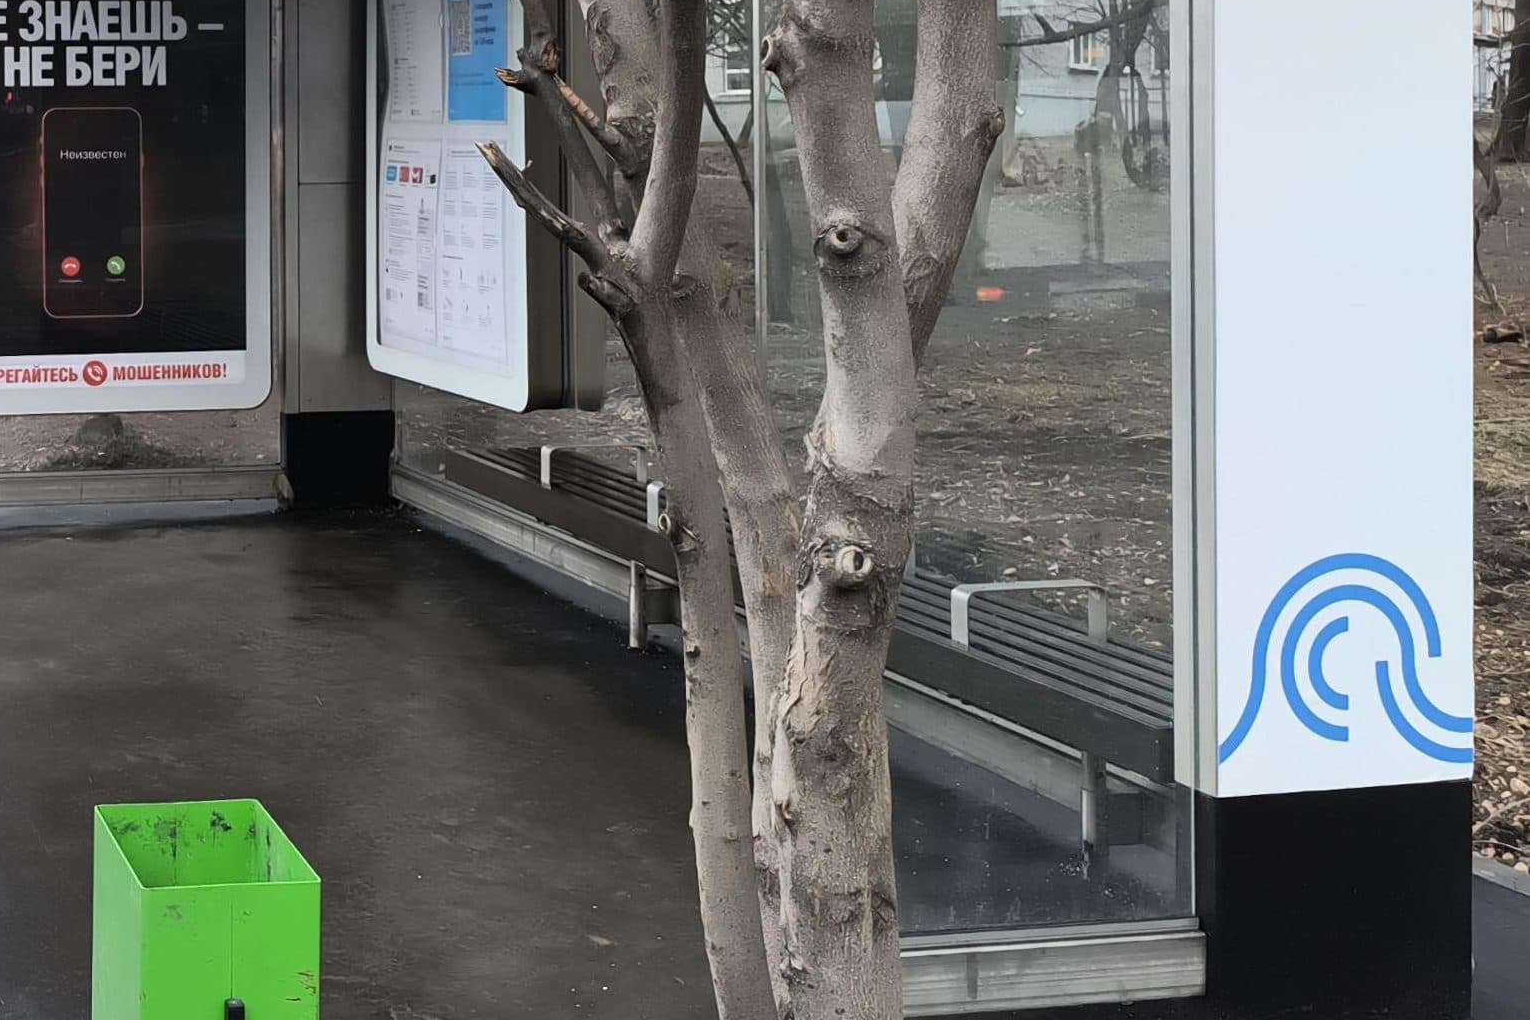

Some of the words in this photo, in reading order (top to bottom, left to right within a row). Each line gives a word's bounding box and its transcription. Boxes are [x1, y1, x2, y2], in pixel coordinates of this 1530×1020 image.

[18, 0, 188, 42] ЗНАЕШЬ
[4, 46, 55, 87] НЕ
[65, 46, 167, 86] БЕРИ
[59, 148, 127, 160] Неизвестен
[112, 363, 227, 381] МОШЕННИКОВ!
